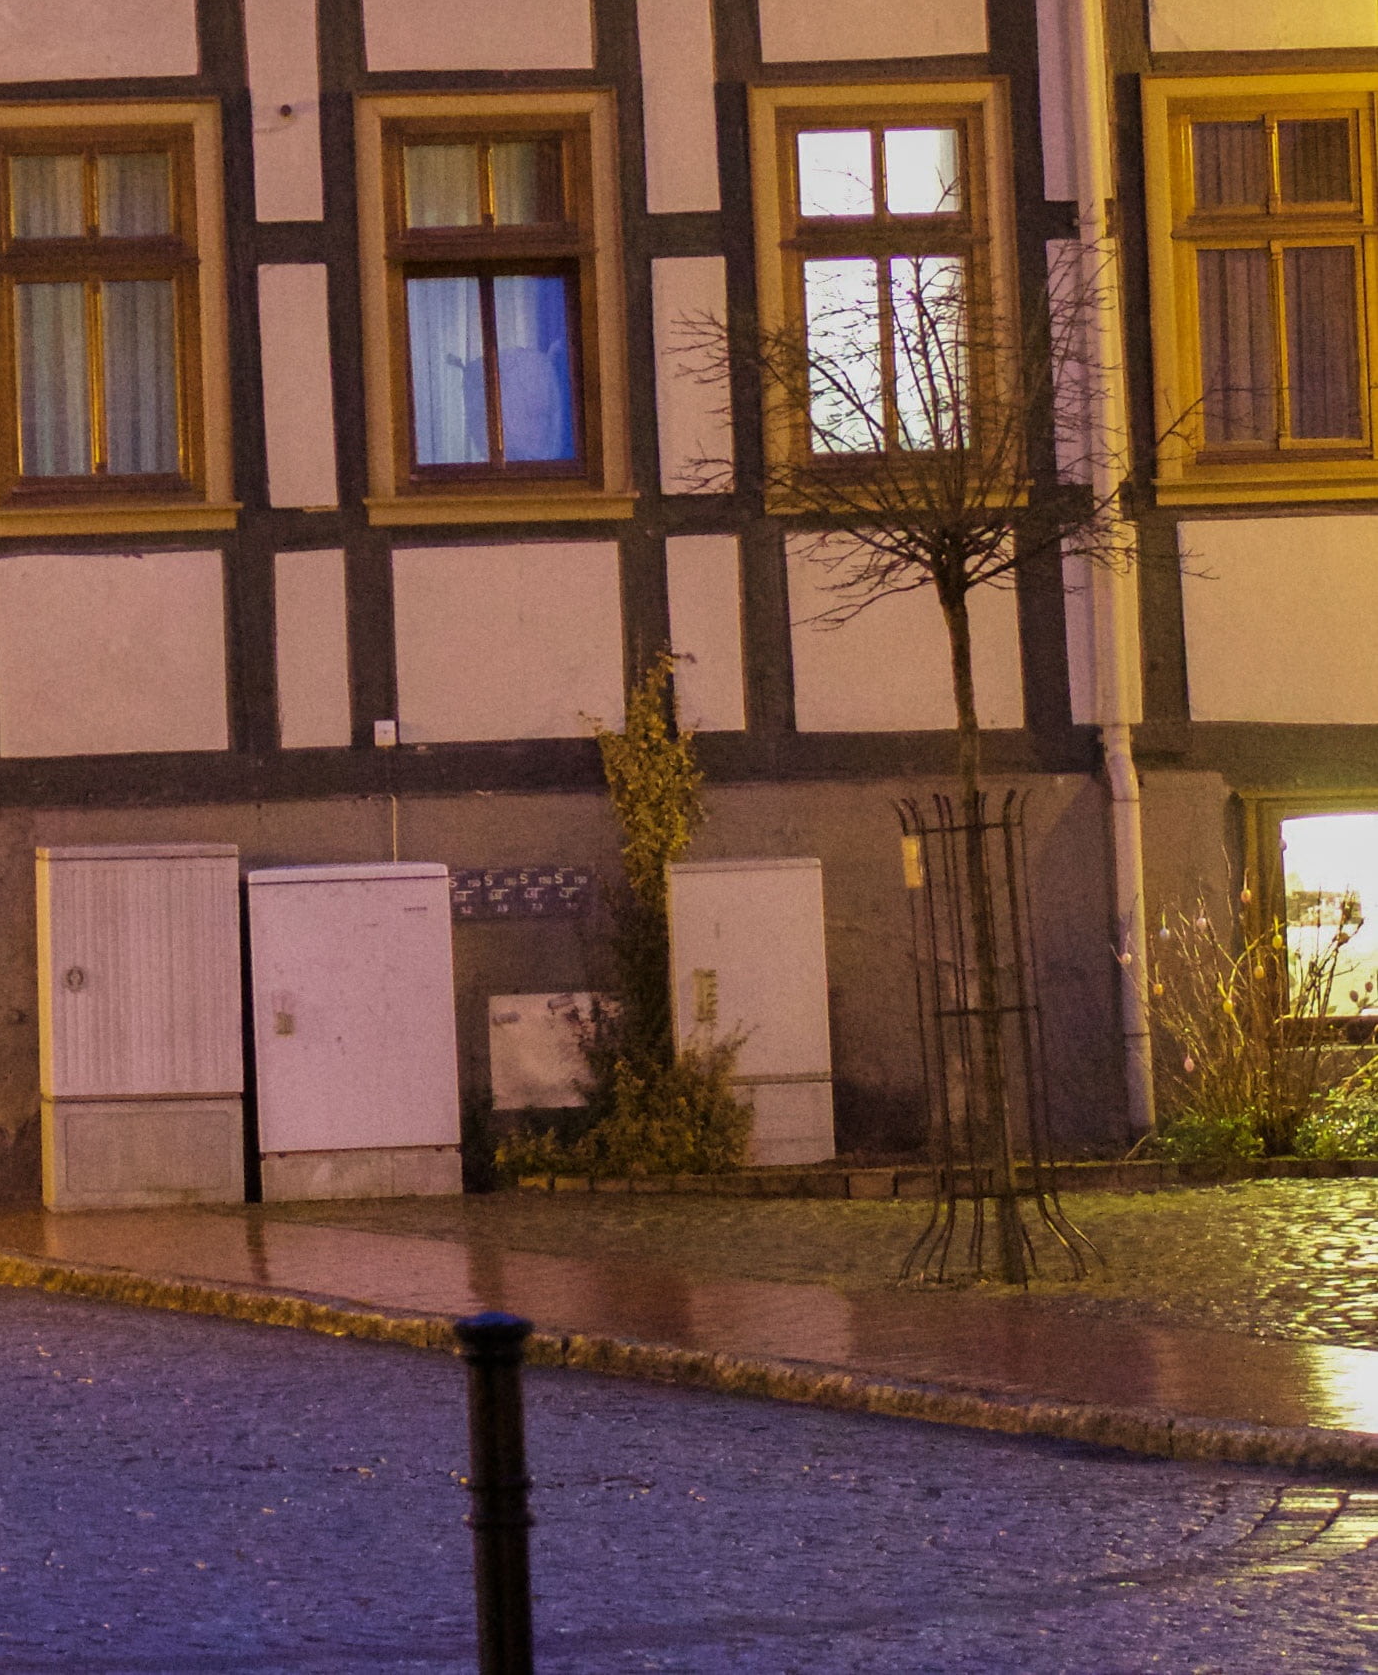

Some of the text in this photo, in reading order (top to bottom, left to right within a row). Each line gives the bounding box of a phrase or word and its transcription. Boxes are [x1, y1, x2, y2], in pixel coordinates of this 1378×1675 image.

[484, 874, 494, 886] S
[519, 873, 529, 885] S
[554, 872, 564, 884] S
